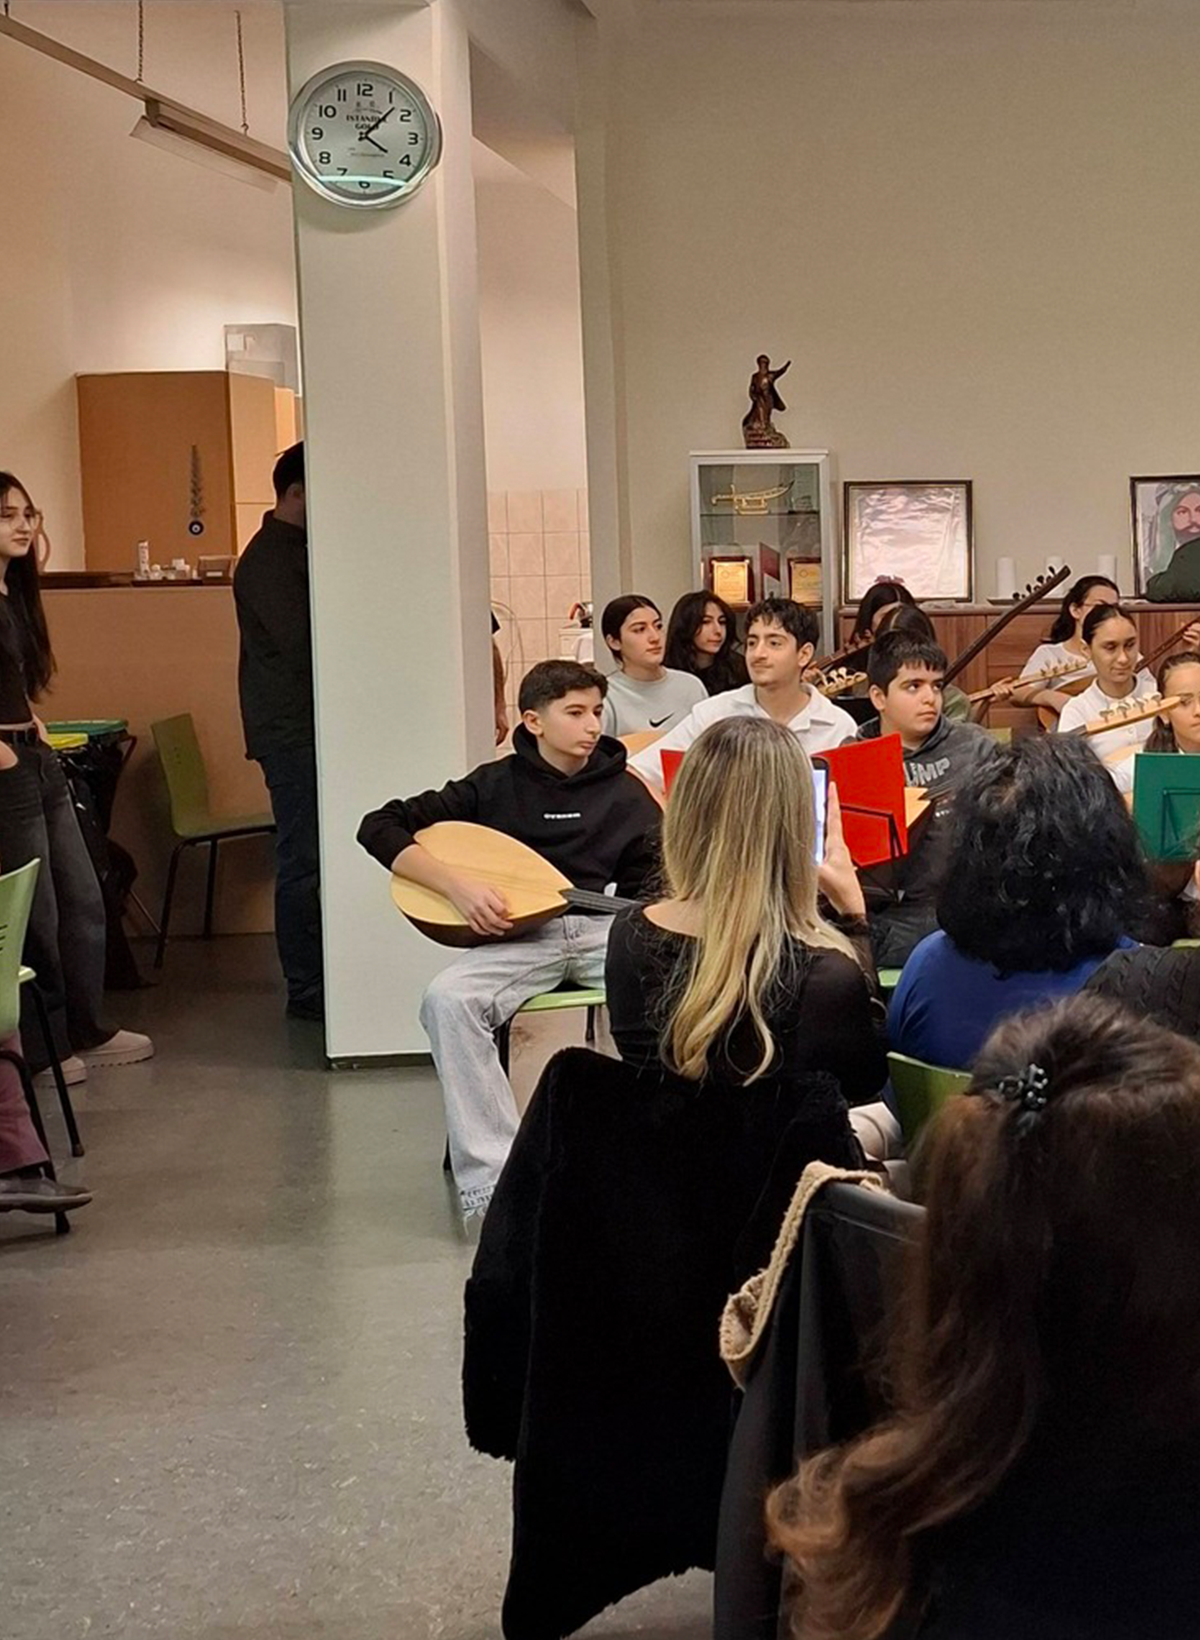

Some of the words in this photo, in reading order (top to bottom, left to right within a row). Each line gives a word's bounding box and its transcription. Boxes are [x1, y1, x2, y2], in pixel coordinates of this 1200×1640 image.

[338, 89, 346, 102] 11
[357, 83, 373, 97] 12
[389, 92, 392, 104] 1
[319, 105, 336, 118] 10
[400, 110, 411, 122] 2
[312, 128, 323, 140] 9
[408, 132, 419, 145] 3
[319, 152, 331, 164] 8
[399, 154, 411, 166] 4
[903, 757, 950, 787] UMP
